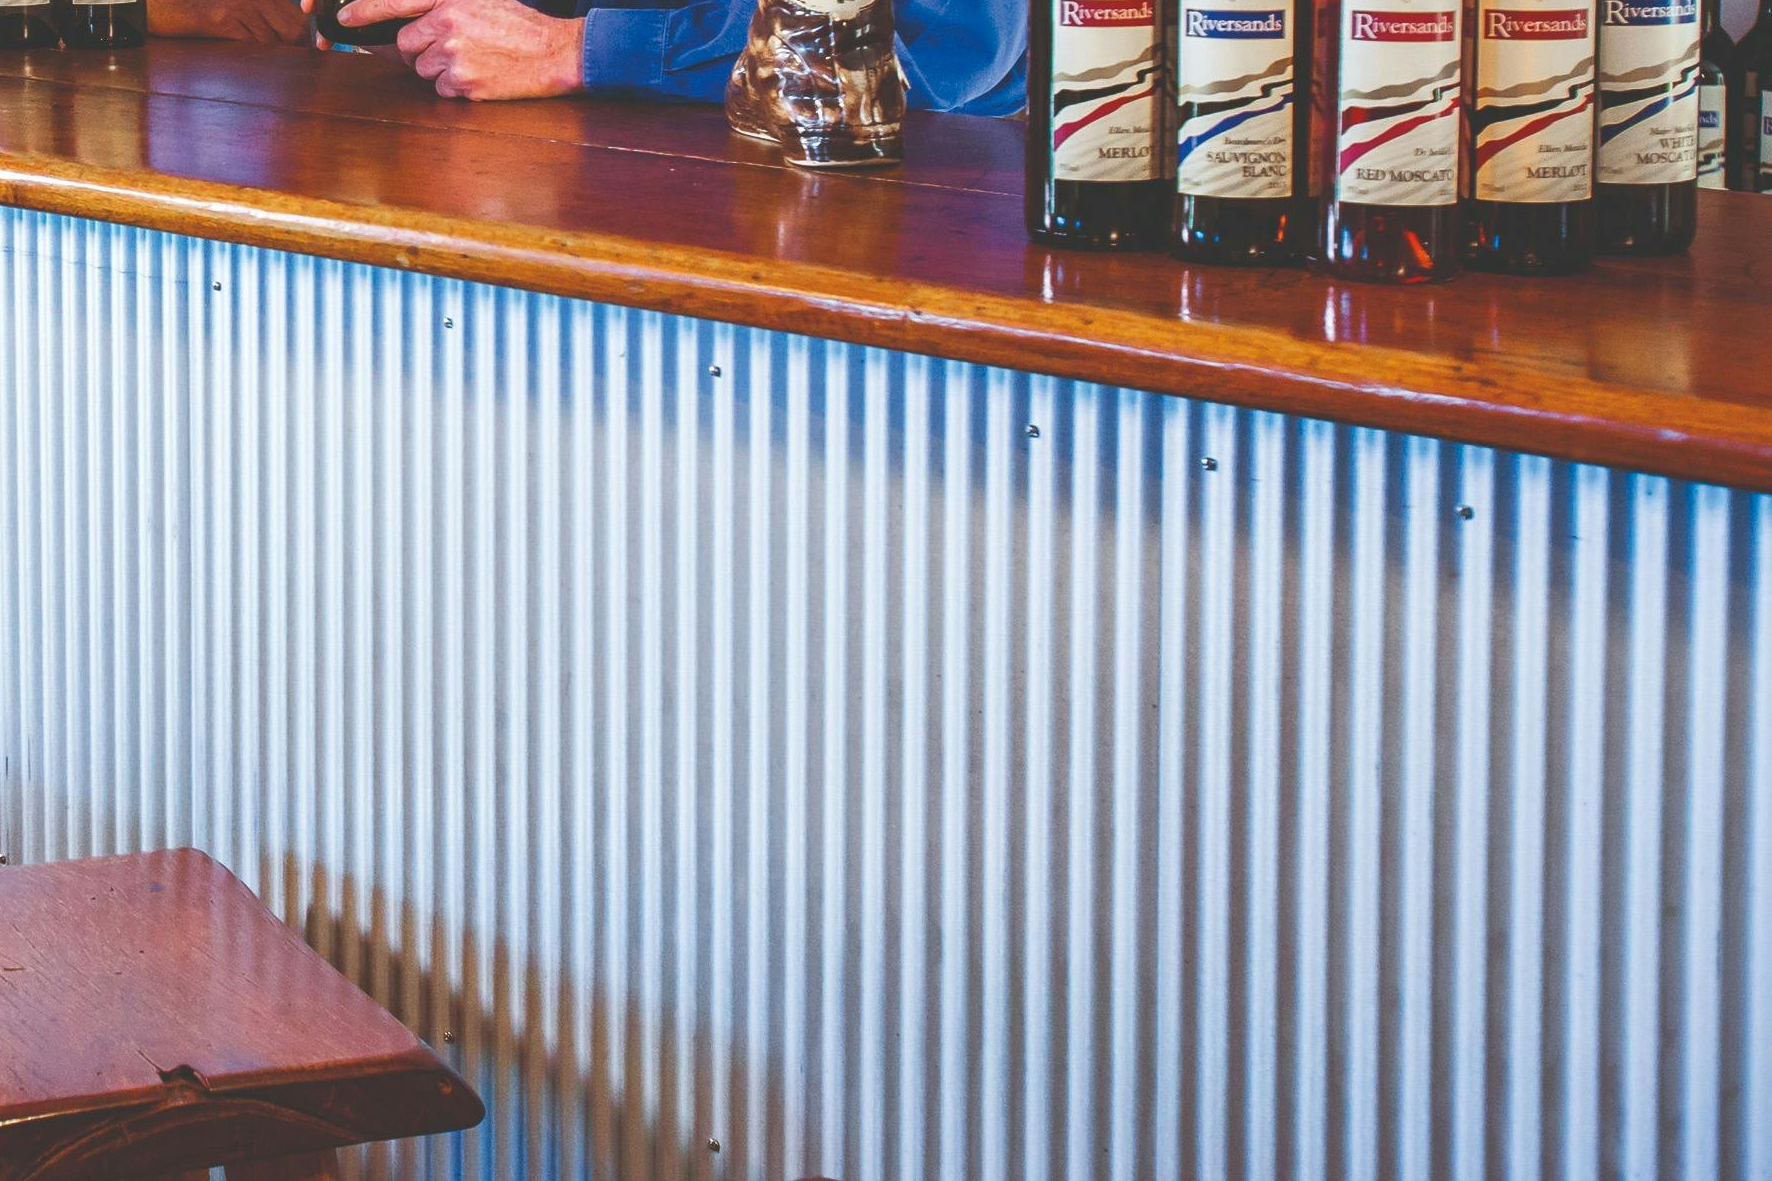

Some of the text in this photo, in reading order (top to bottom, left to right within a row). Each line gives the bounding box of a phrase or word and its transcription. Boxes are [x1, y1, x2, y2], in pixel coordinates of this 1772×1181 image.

[1061, 0, 1154, 26] Riversands
[1187, 11, 1283, 37] Riversands
[1354, 13, 1454, 39] Riversands
[1488, 12, 1587, 38] Riversands
[1659, 135, 1694, 149] WHITE
[1097, 145, 1155, 159] MERLOT
[1205, 150, 1287, 164] SAUVIGNON
[1634, 149, 1696, 165] MOSCATO
[1241, 164, 1287, 178] BLANC
[1355, 167, 1454, 182] RED MOSCATO
[1526, 164, 1588, 179] MERLOT
